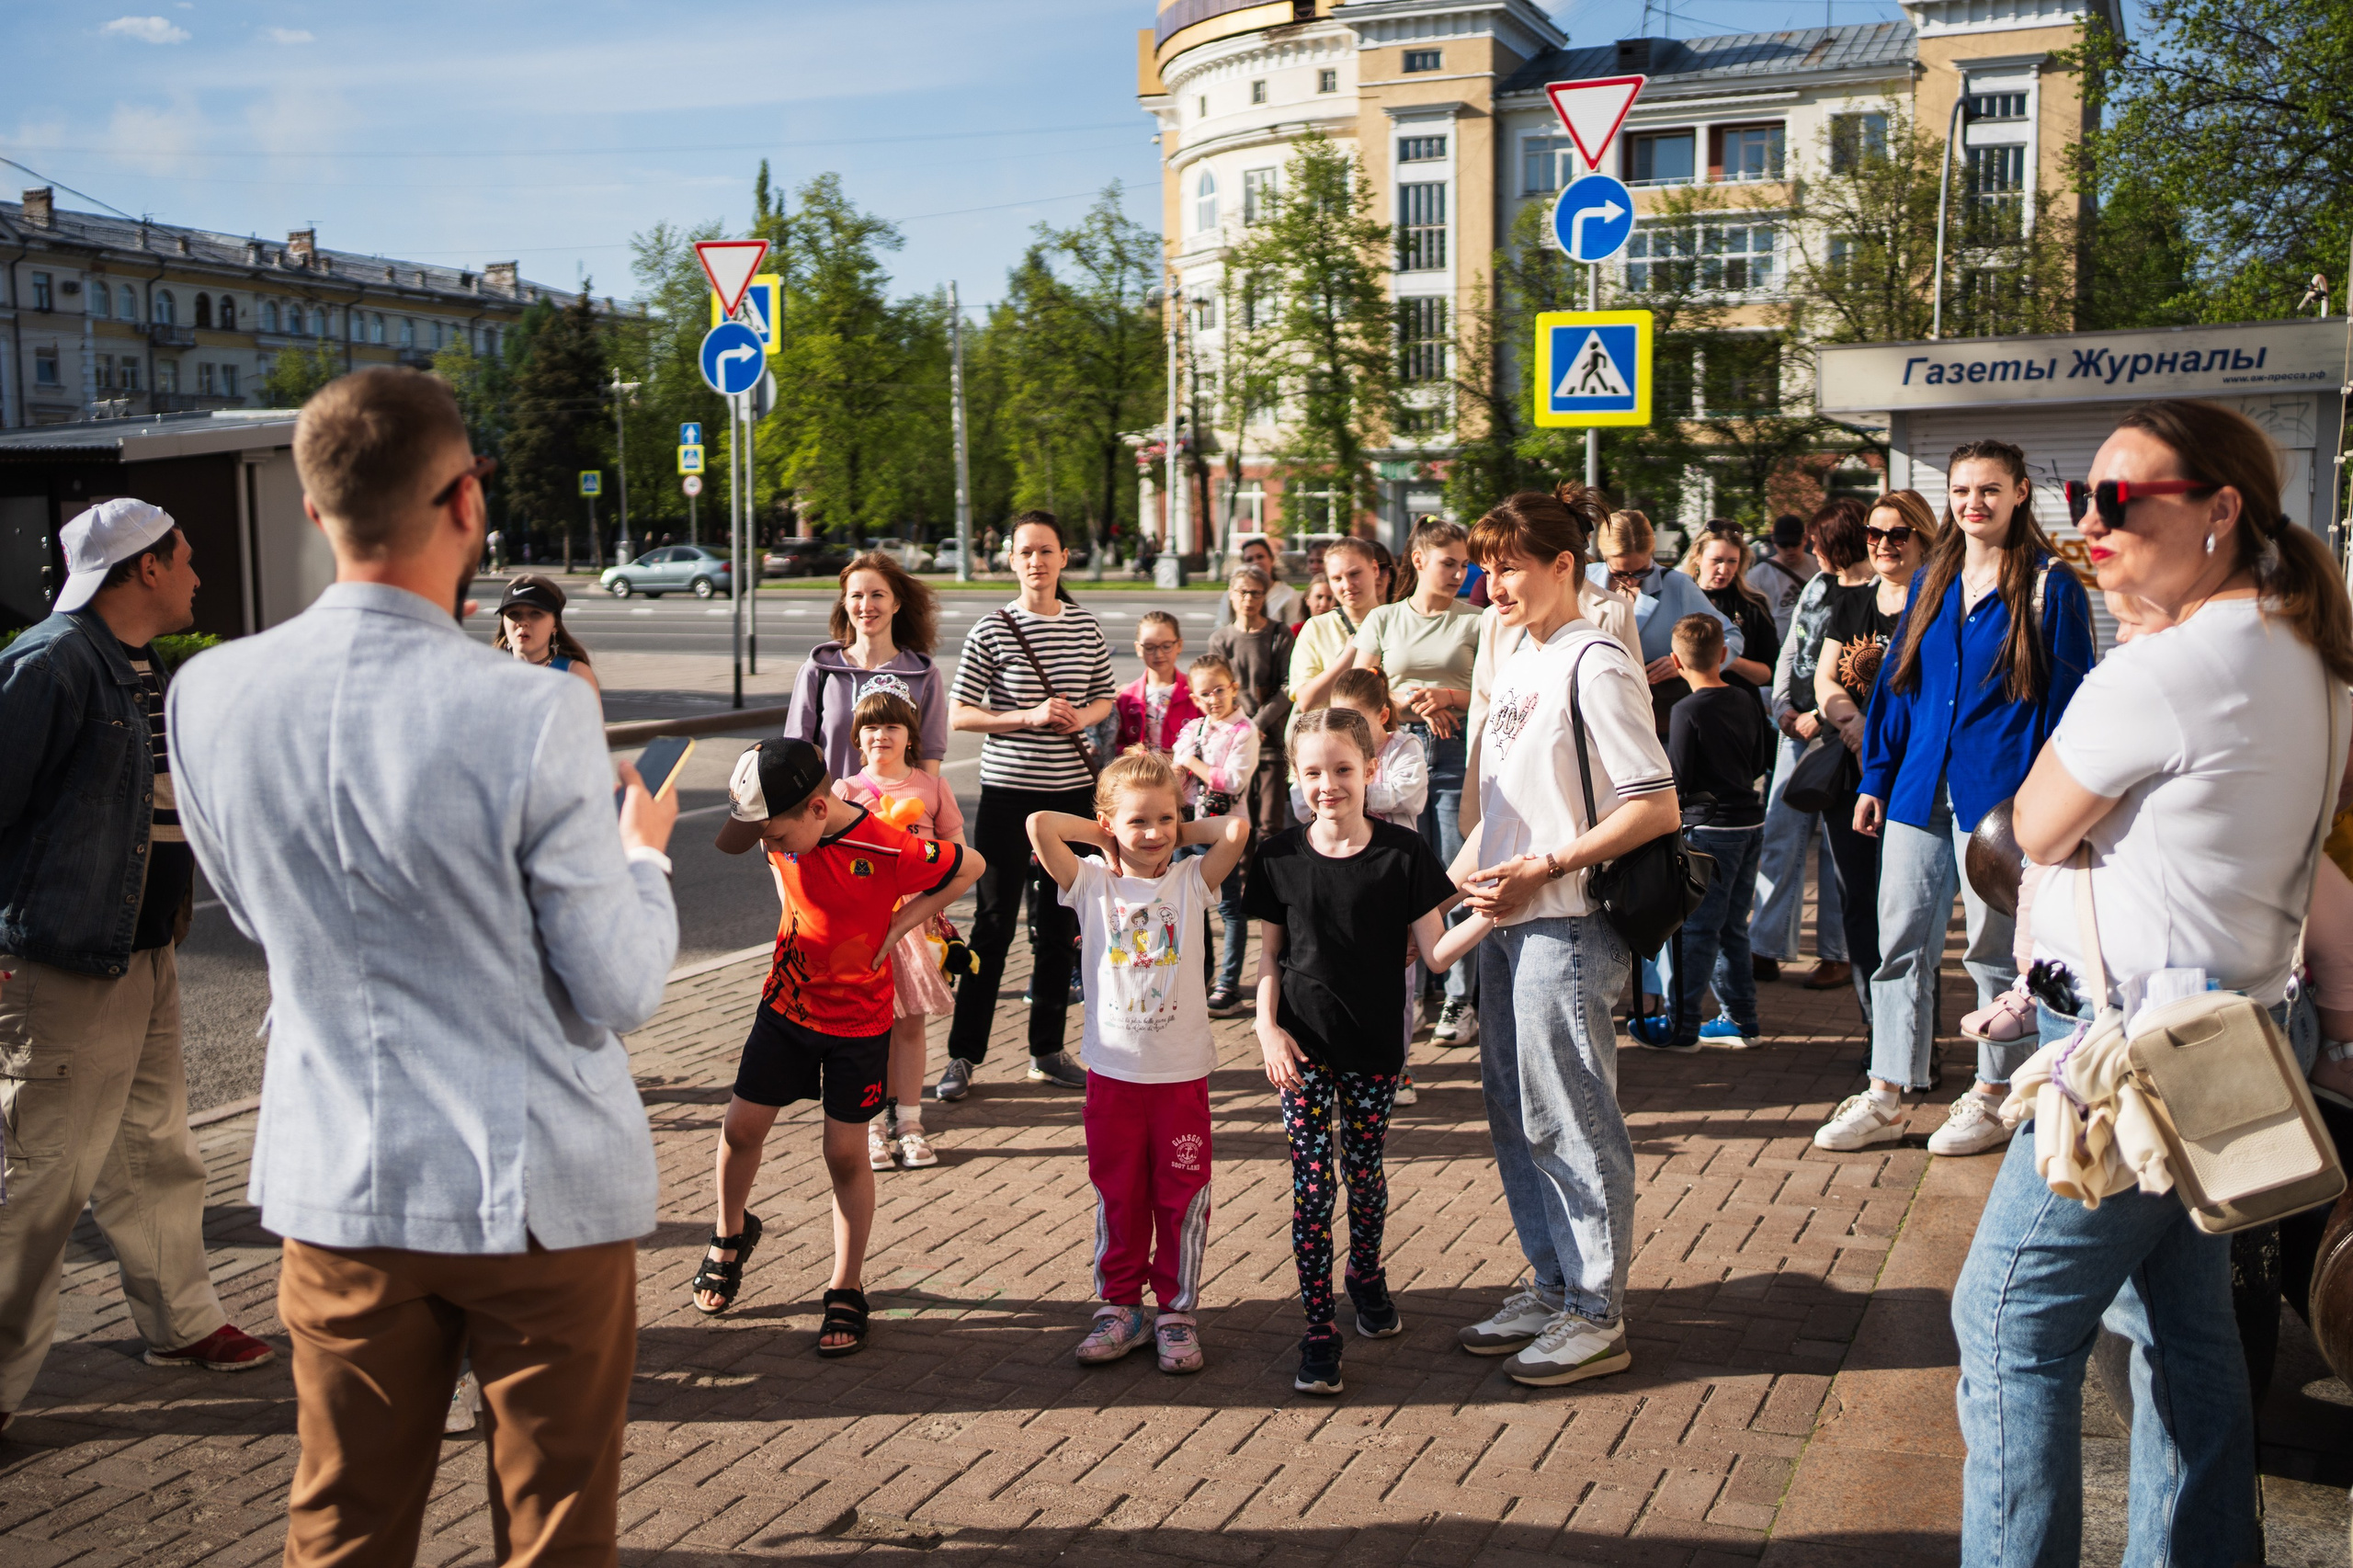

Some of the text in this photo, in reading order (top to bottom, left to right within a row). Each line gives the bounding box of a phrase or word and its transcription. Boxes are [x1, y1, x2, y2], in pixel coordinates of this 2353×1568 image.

[1902, 347, 2268, 385] Газеты Журналы
[1172, 1133, 1203, 1147] GLASGOW
